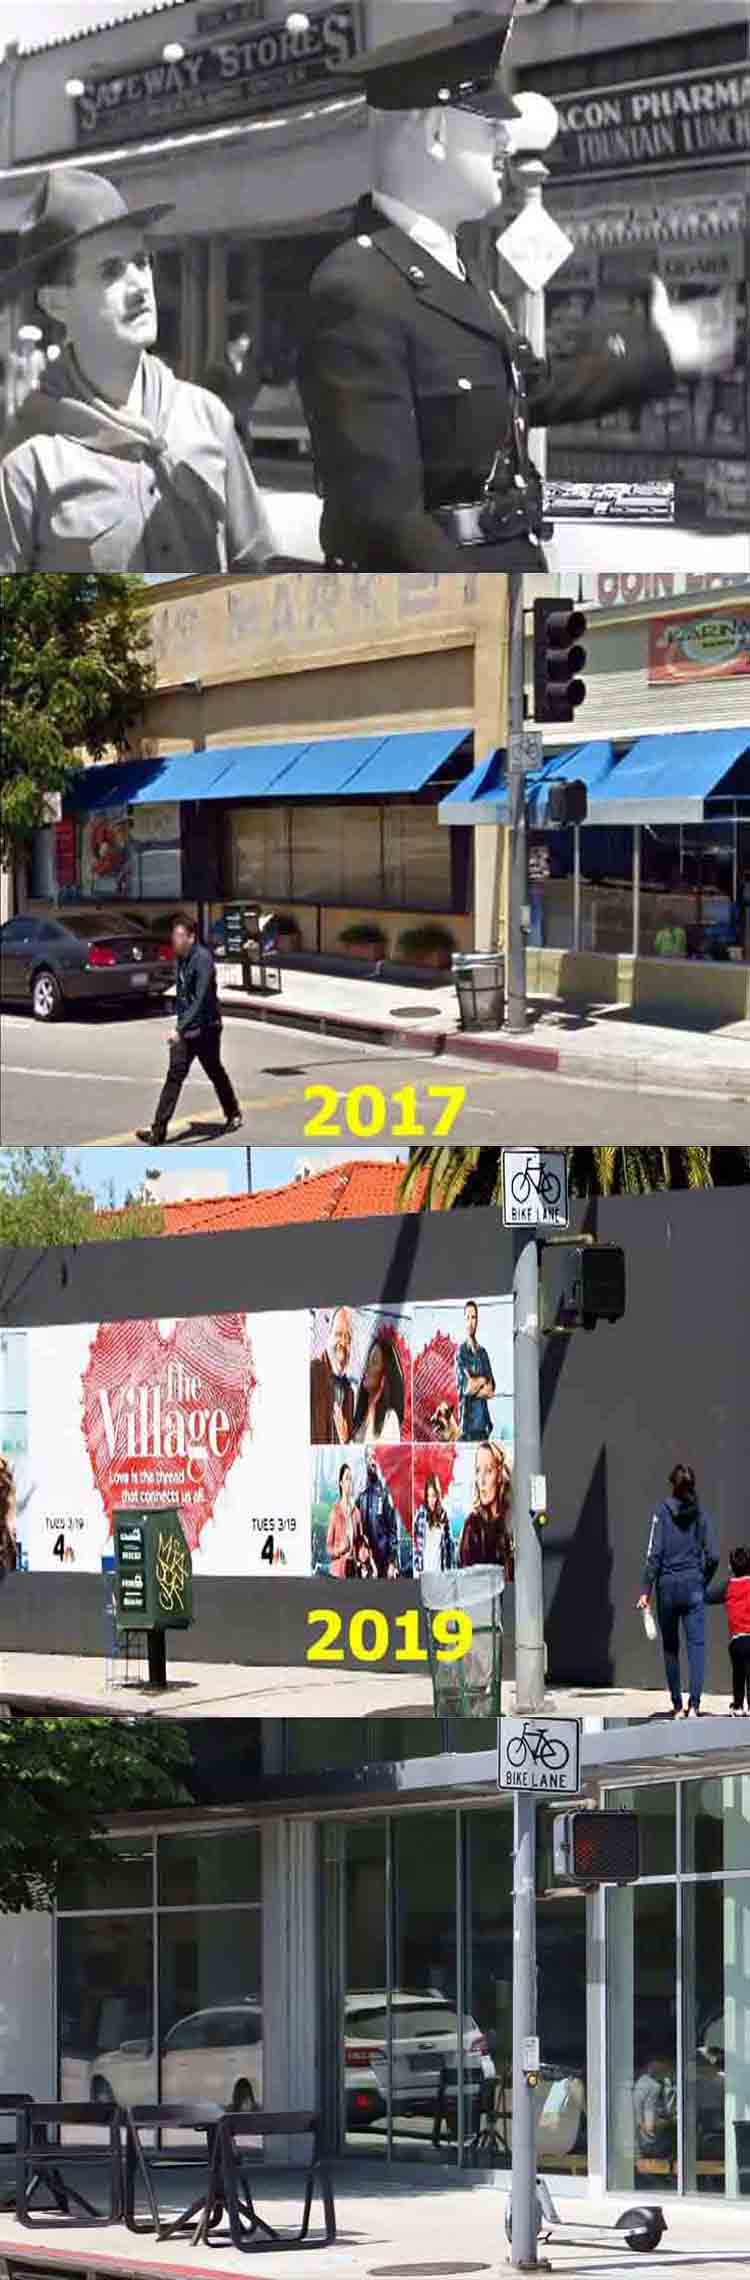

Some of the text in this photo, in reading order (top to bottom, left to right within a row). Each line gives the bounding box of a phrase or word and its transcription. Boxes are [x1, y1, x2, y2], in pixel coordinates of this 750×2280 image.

[77, 57, 204, 130] SAFEWAY
[219, 12, 351, 73] STORES
[511, 1207, 560, 1223] BIKE LANE
[98, 1384, 230, 1482] Village
[46, 1516, 64, 1529] TUES
[252, 1517, 297, 1531] TUES 3/19
[53, 1533, 65, 1563] 4
[261, 1534, 274, 1566] 4
[506, 1771, 567, 1788] BIKE LANE
